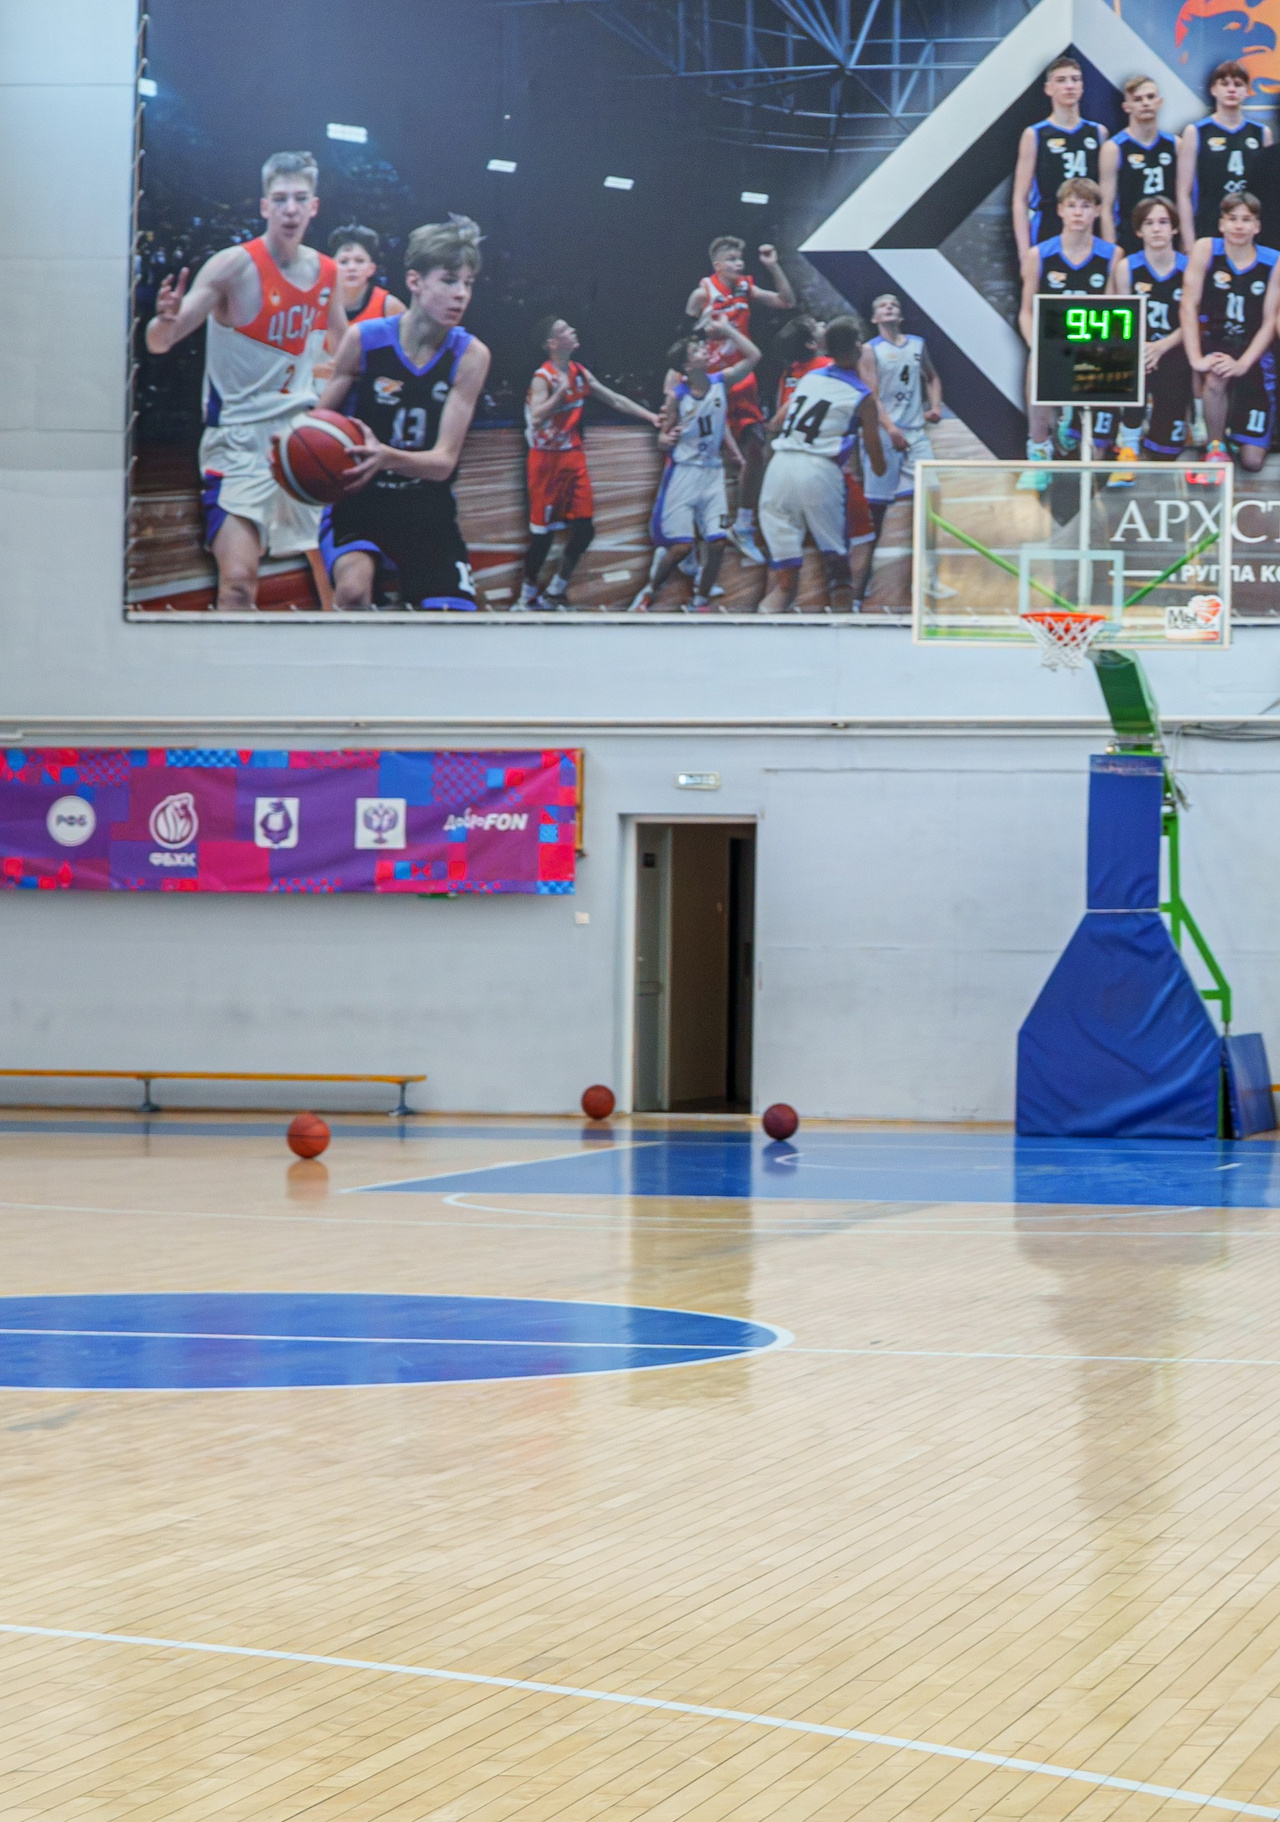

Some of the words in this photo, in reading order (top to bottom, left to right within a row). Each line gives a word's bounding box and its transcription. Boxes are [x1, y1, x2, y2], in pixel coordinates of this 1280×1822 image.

[1062, 150, 1088, 178] 34
[1227, 150, 1245, 176] 4
[1143, 166, 1165, 195] 23
[1226, 293, 1245, 322] 11
[1246, 409, 1266, 434] 11
